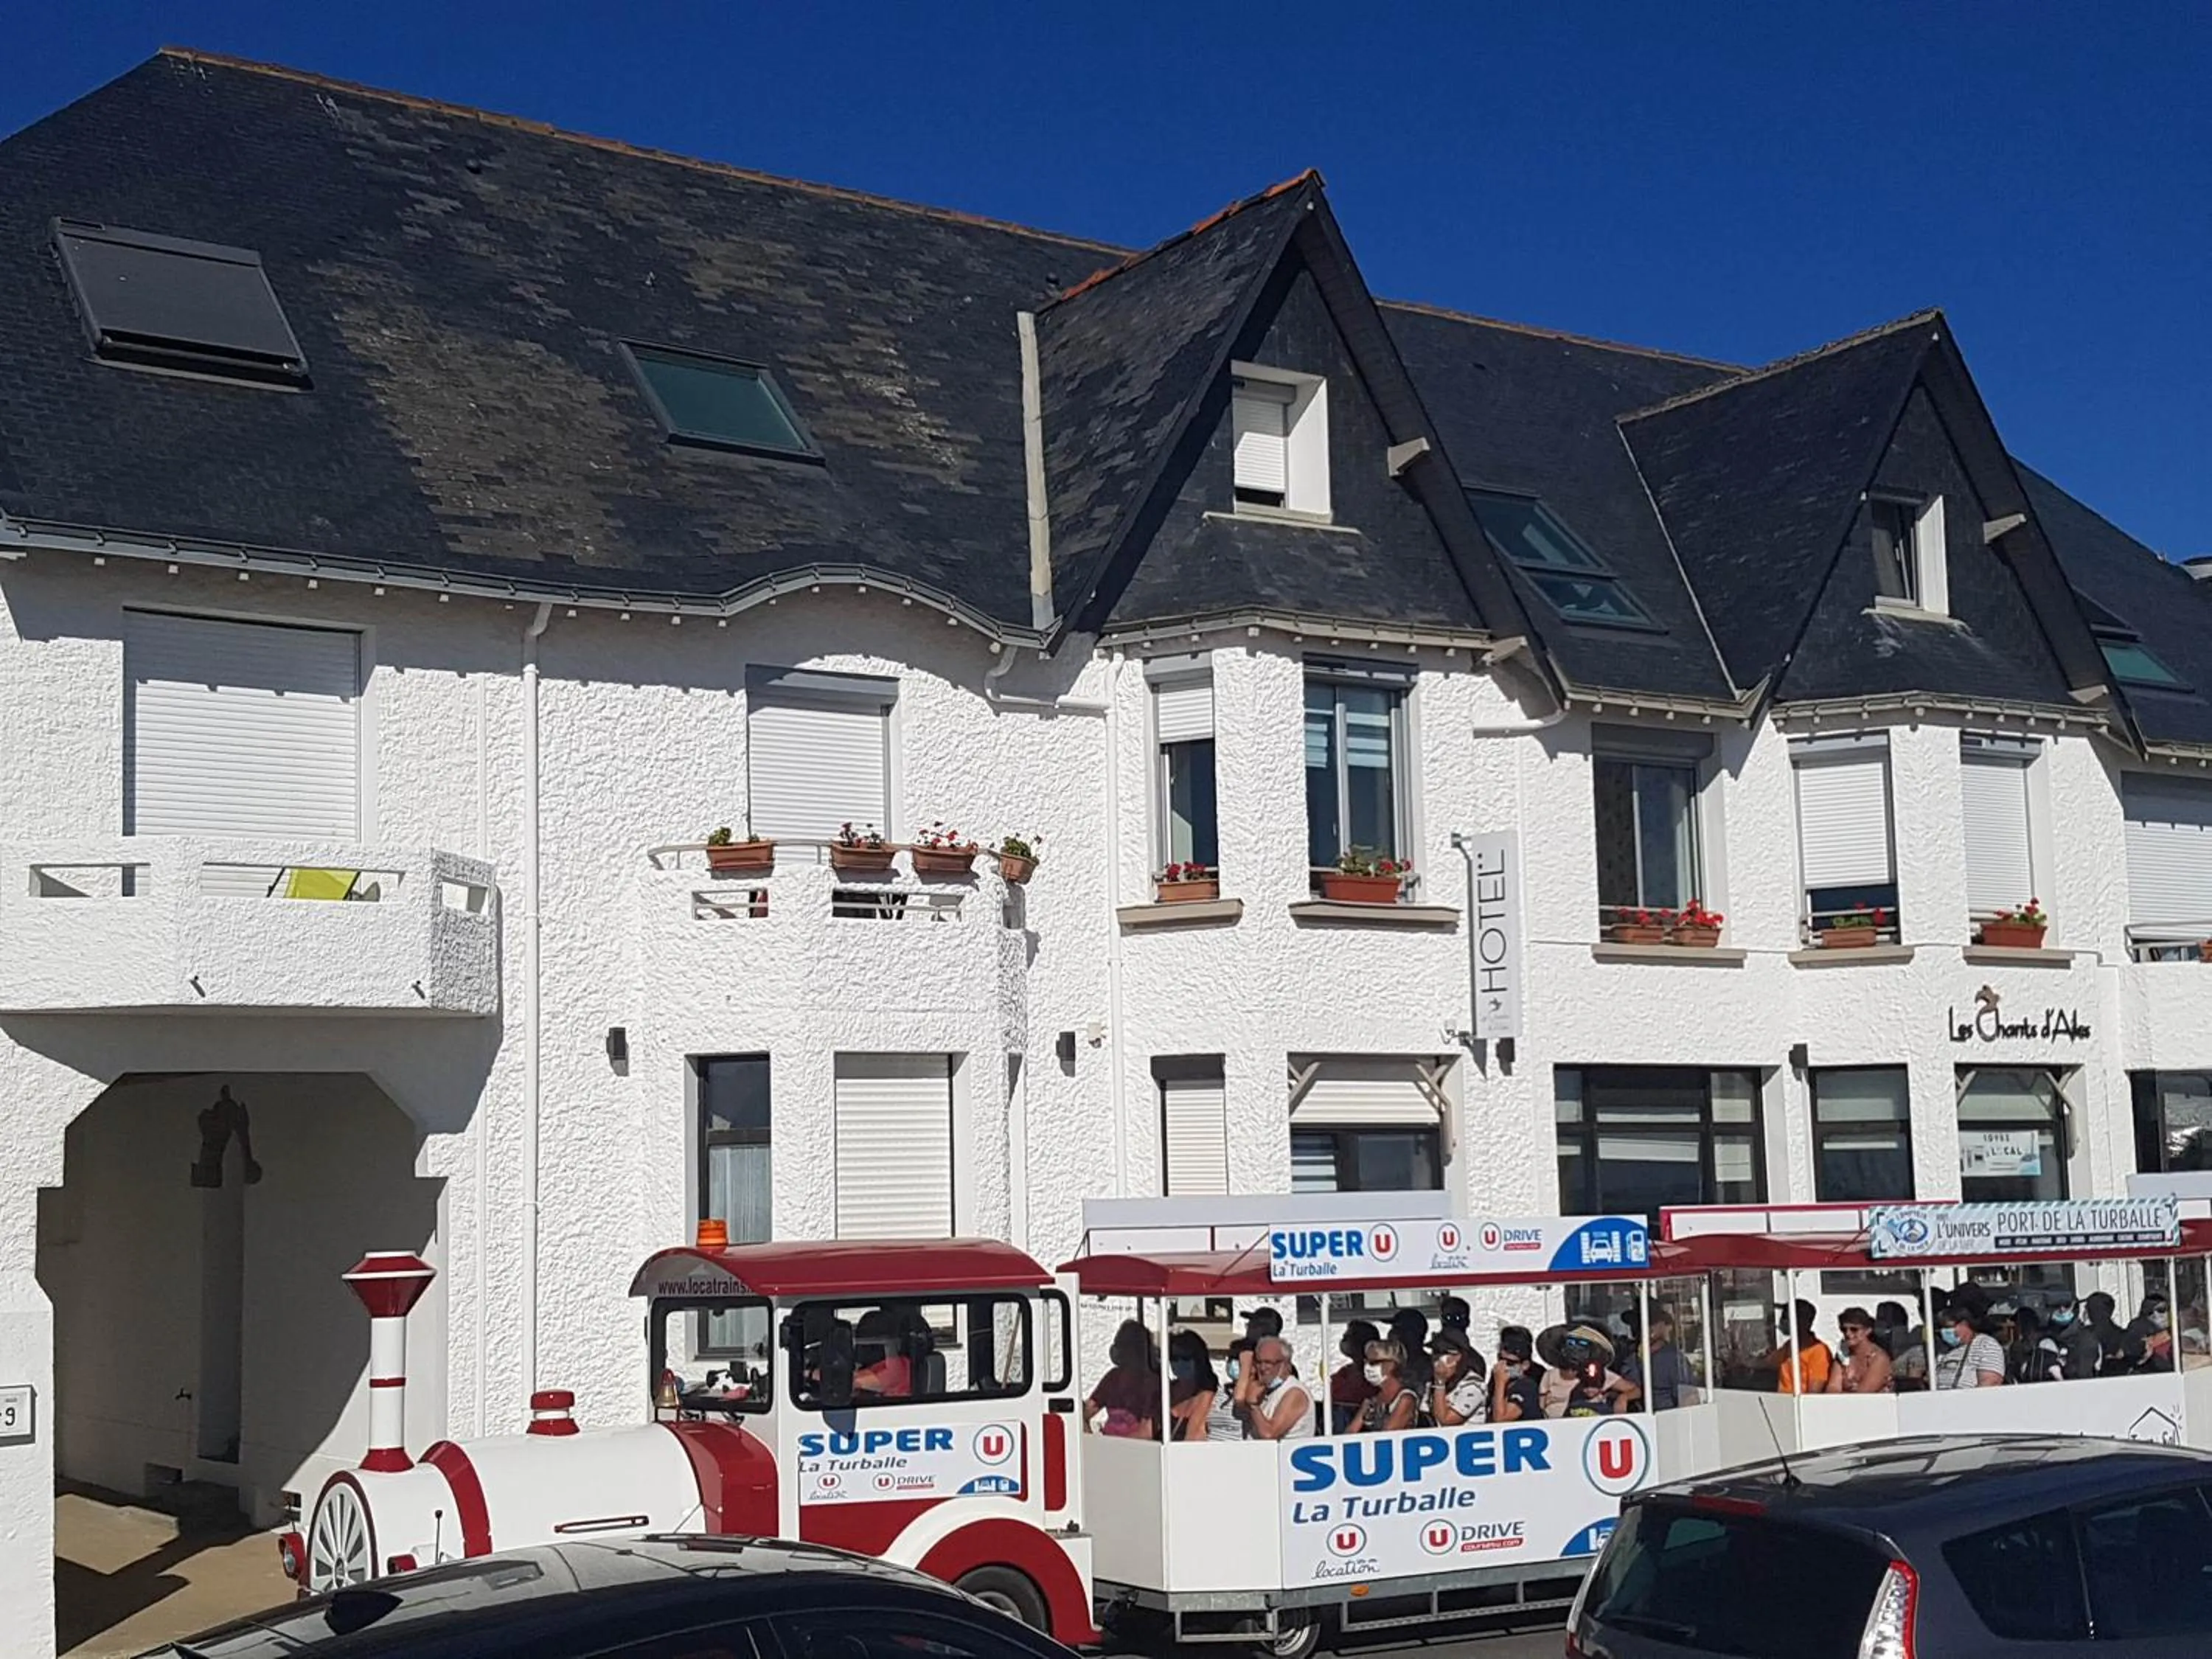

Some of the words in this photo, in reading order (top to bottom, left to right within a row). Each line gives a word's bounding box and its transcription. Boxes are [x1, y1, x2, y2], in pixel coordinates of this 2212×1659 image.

[1478, 849, 1507, 993] HOTEL
[1949, 1006, 1973, 1043] Les
[1976, 1006, 2038, 1043] Chants
[1937, 1222, 1990, 1238] L'UNIVERS
[1997, 1211, 2034, 1232] PORT
[2042, 1210, 2061, 1231] DE
[2067, 1209, 2086, 1229] LA
[2091, 1207, 2161, 1229] TURBALLE
[1271, 1231, 1363, 1259] SUPER
[1503, 1229, 1542, 1241] DRIVE
[1273, 1264, 1285, 1276] La
[1289, 1262, 1337, 1276] Turballe
[799, 1428, 953, 1457] SUPER
[799, 1460, 820, 1472] La
[828, 1457, 907, 1471] Turballe
[1290, 1427, 1551, 1492] SUPER
[1599, 1439, 1633, 1478] U
[897, 1475, 936, 1484] DRIVE
[1293, 1502, 1328, 1524] La
[1342, 1487, 1475, 1519] Turballe
[1461, 1521, 1525, 1541] DRIVE
[1311, 1559, 1380, 1580] location
